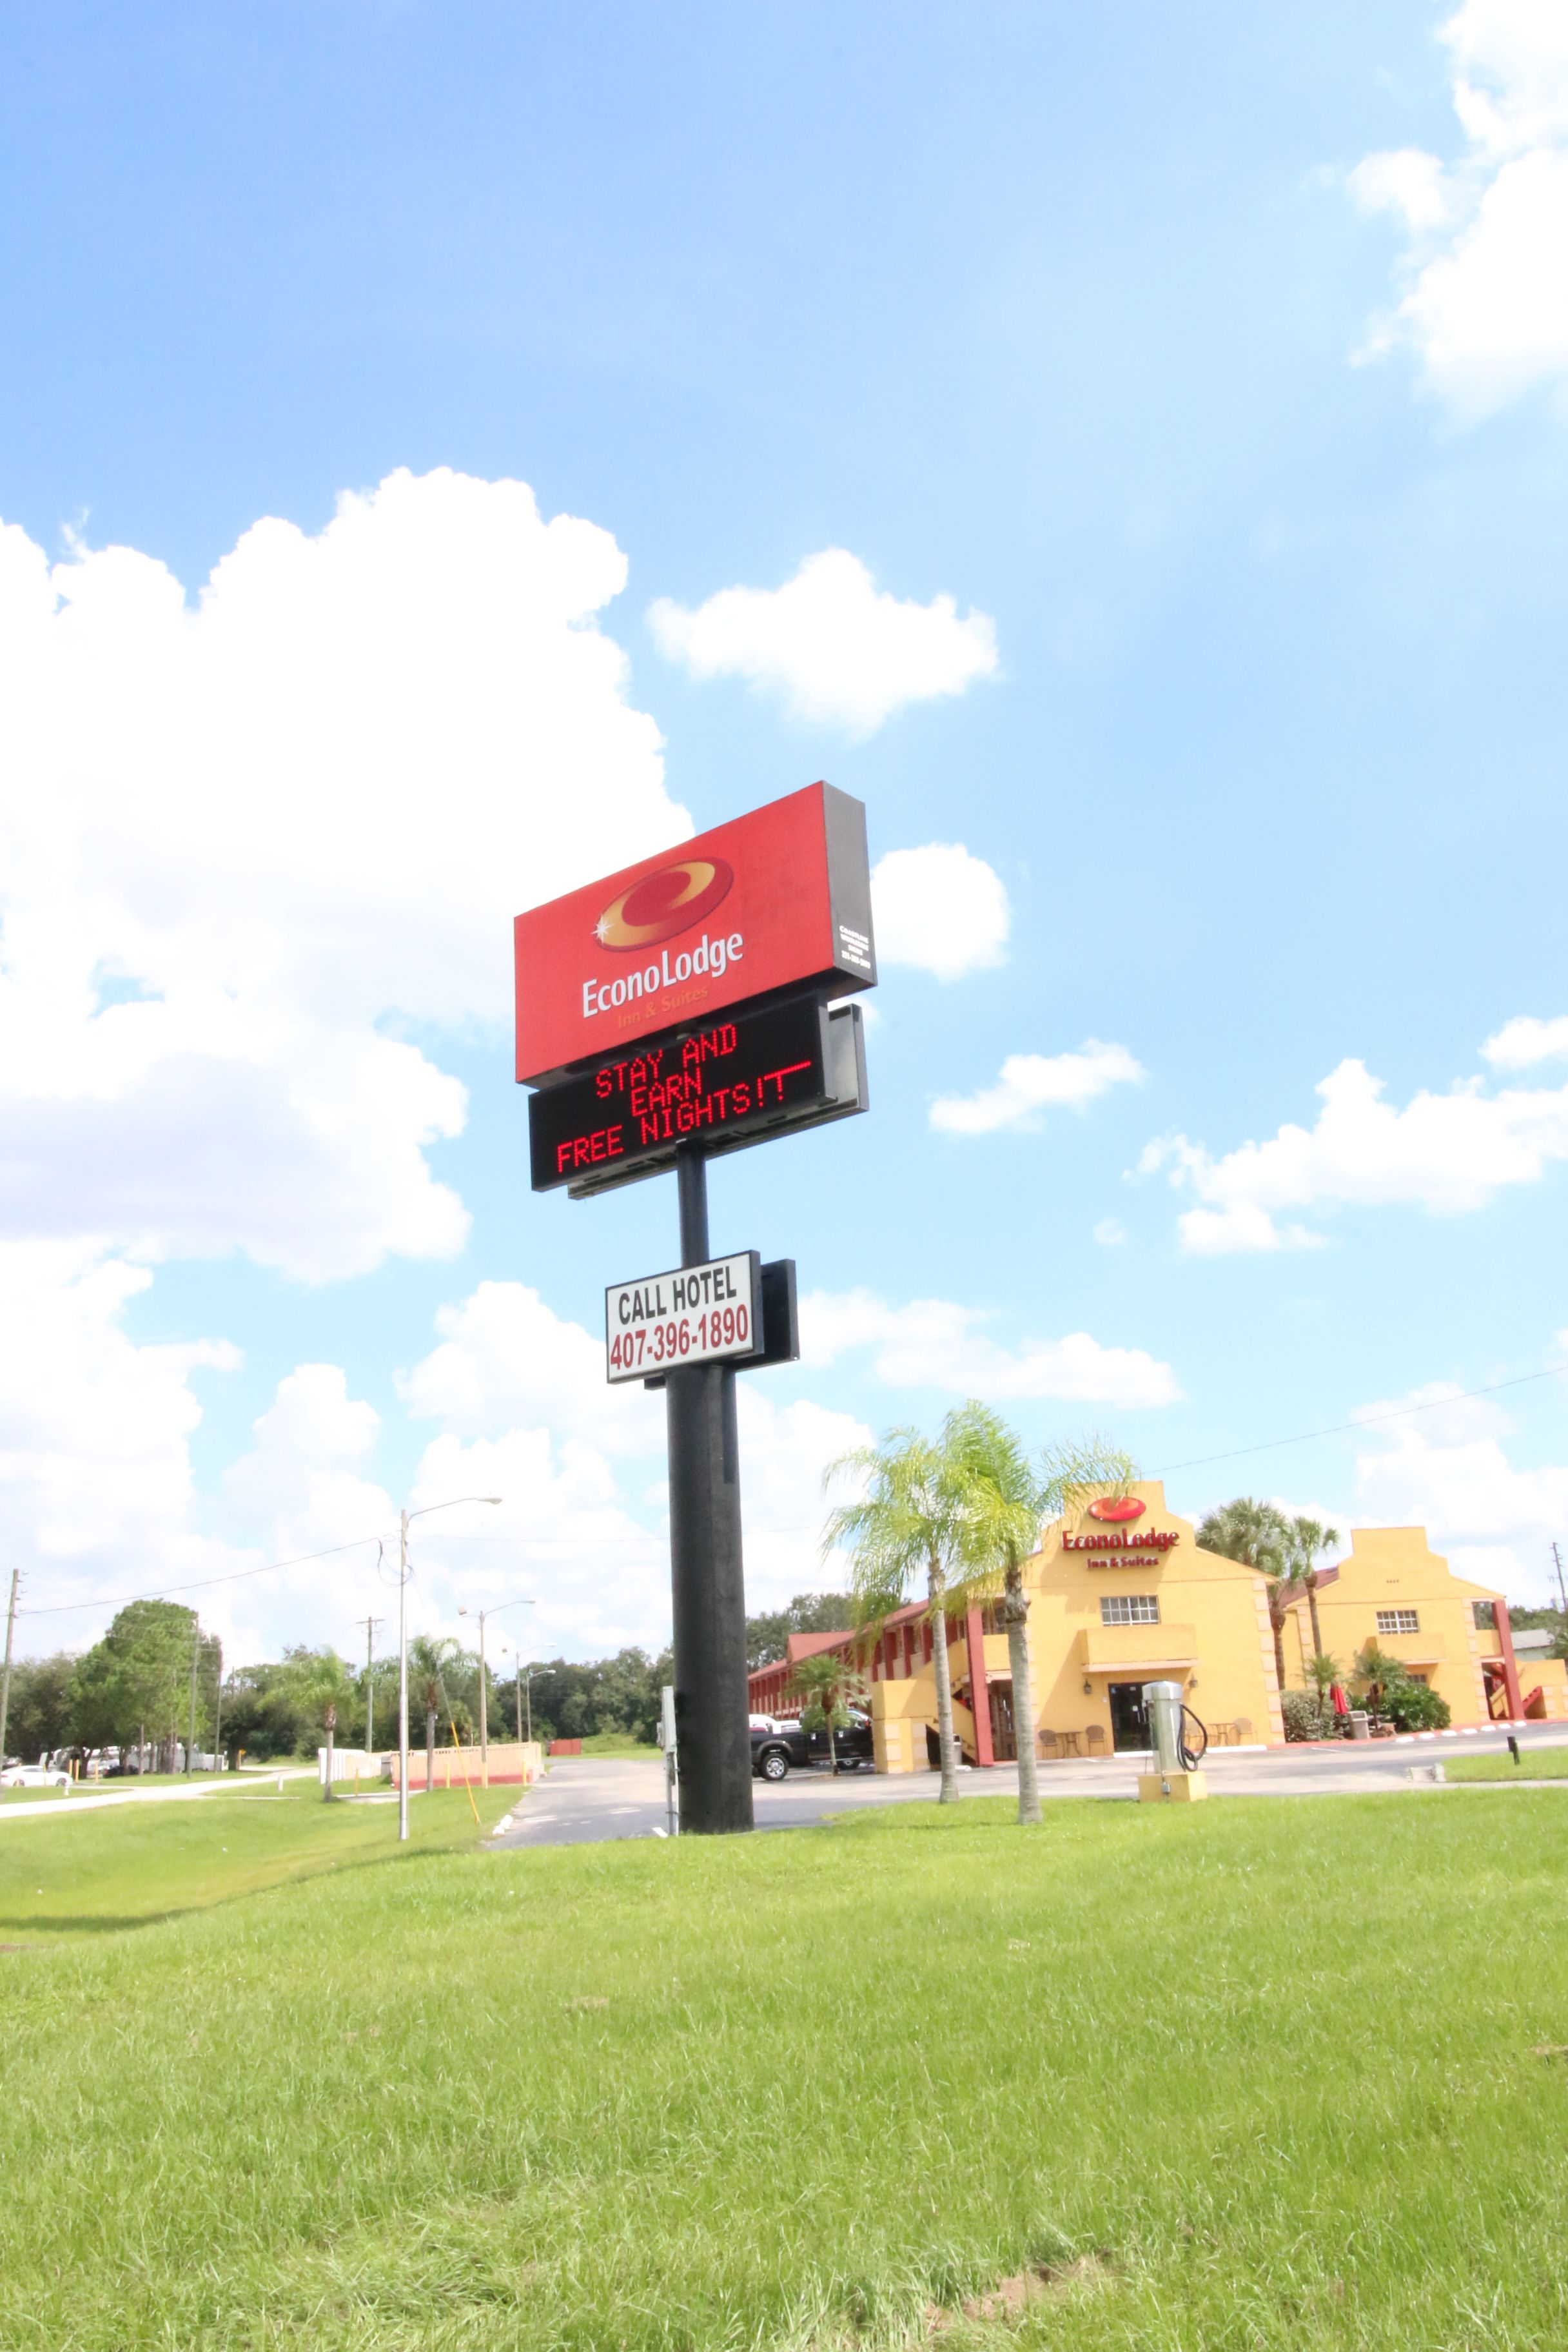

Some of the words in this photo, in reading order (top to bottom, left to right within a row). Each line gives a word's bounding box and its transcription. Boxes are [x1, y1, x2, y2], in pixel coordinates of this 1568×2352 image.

[582, 933, 743, 1018] EconoLodge
[618, 1012, 640, 1029] Inn
[646, 1001, 657, 1018] &
[662, 987, 708, 1012] Suites
[596, 1049, 663, 1098] STAY
[683, 1023, 736, 1068] AND
[631, 1067, 701, 1117] EARN
[557, 1124, 623, 1173] FREE
[619, 1284, 667, 1325] CALL
[673, 1266, 737, 1311] HOTEL
[611, 1304, 748, 1370] 407-396-1890
[1063, 1527, 1179, 1552] EconoLodge
[1087, 1558, 1107, 1568] Inn
[1110, 1557, 1121, 1567] &
[1121, 1556, 1159, 1567] Suites
